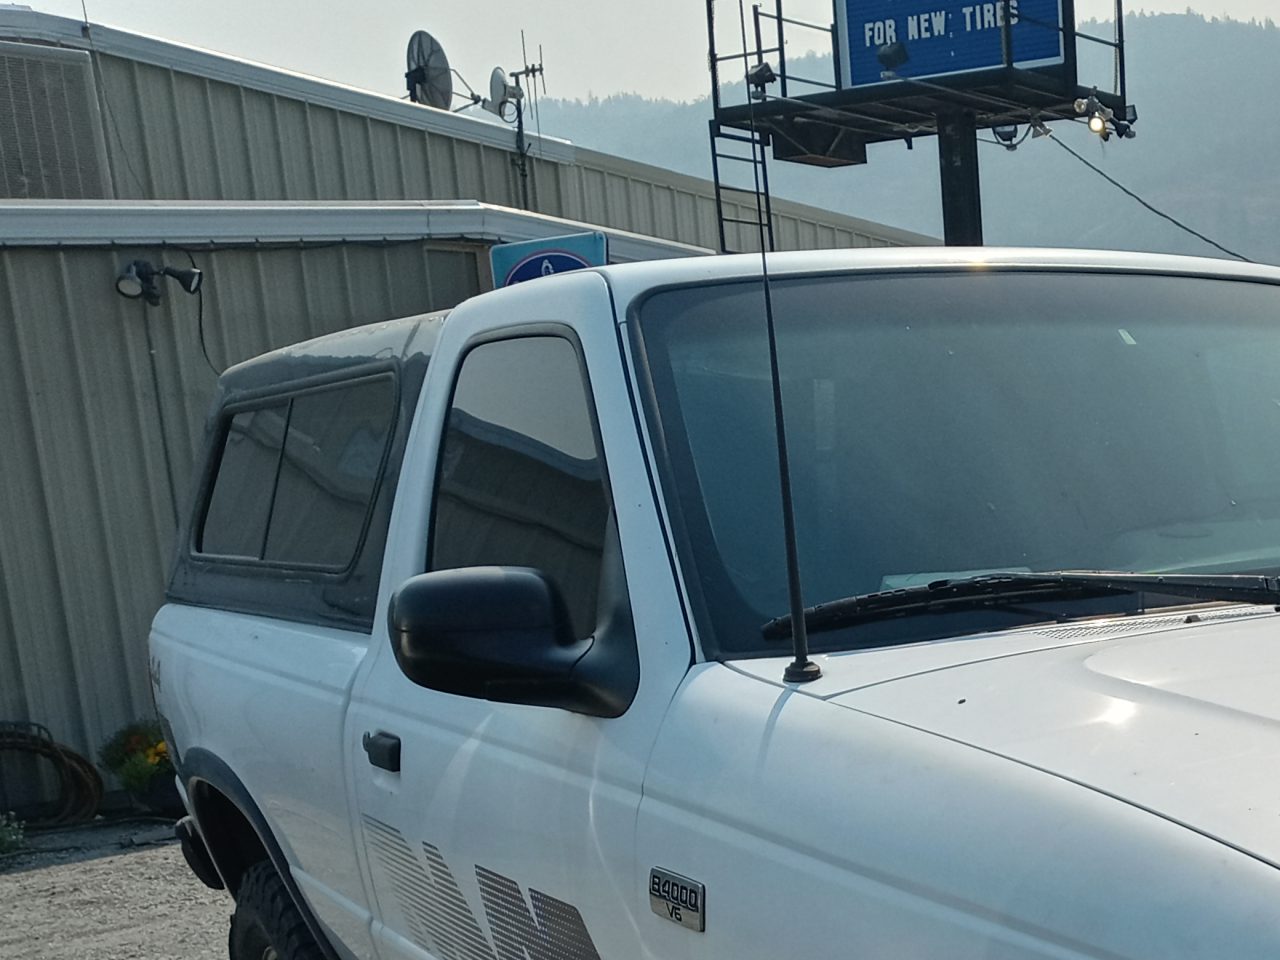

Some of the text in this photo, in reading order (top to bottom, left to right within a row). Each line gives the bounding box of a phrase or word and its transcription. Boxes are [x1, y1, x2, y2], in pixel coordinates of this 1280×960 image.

[864, 0, 1020, 48] FOR NEW TIRES
[651, 874, 699, 911] B4000
[665, 902, 682, 922] V6
